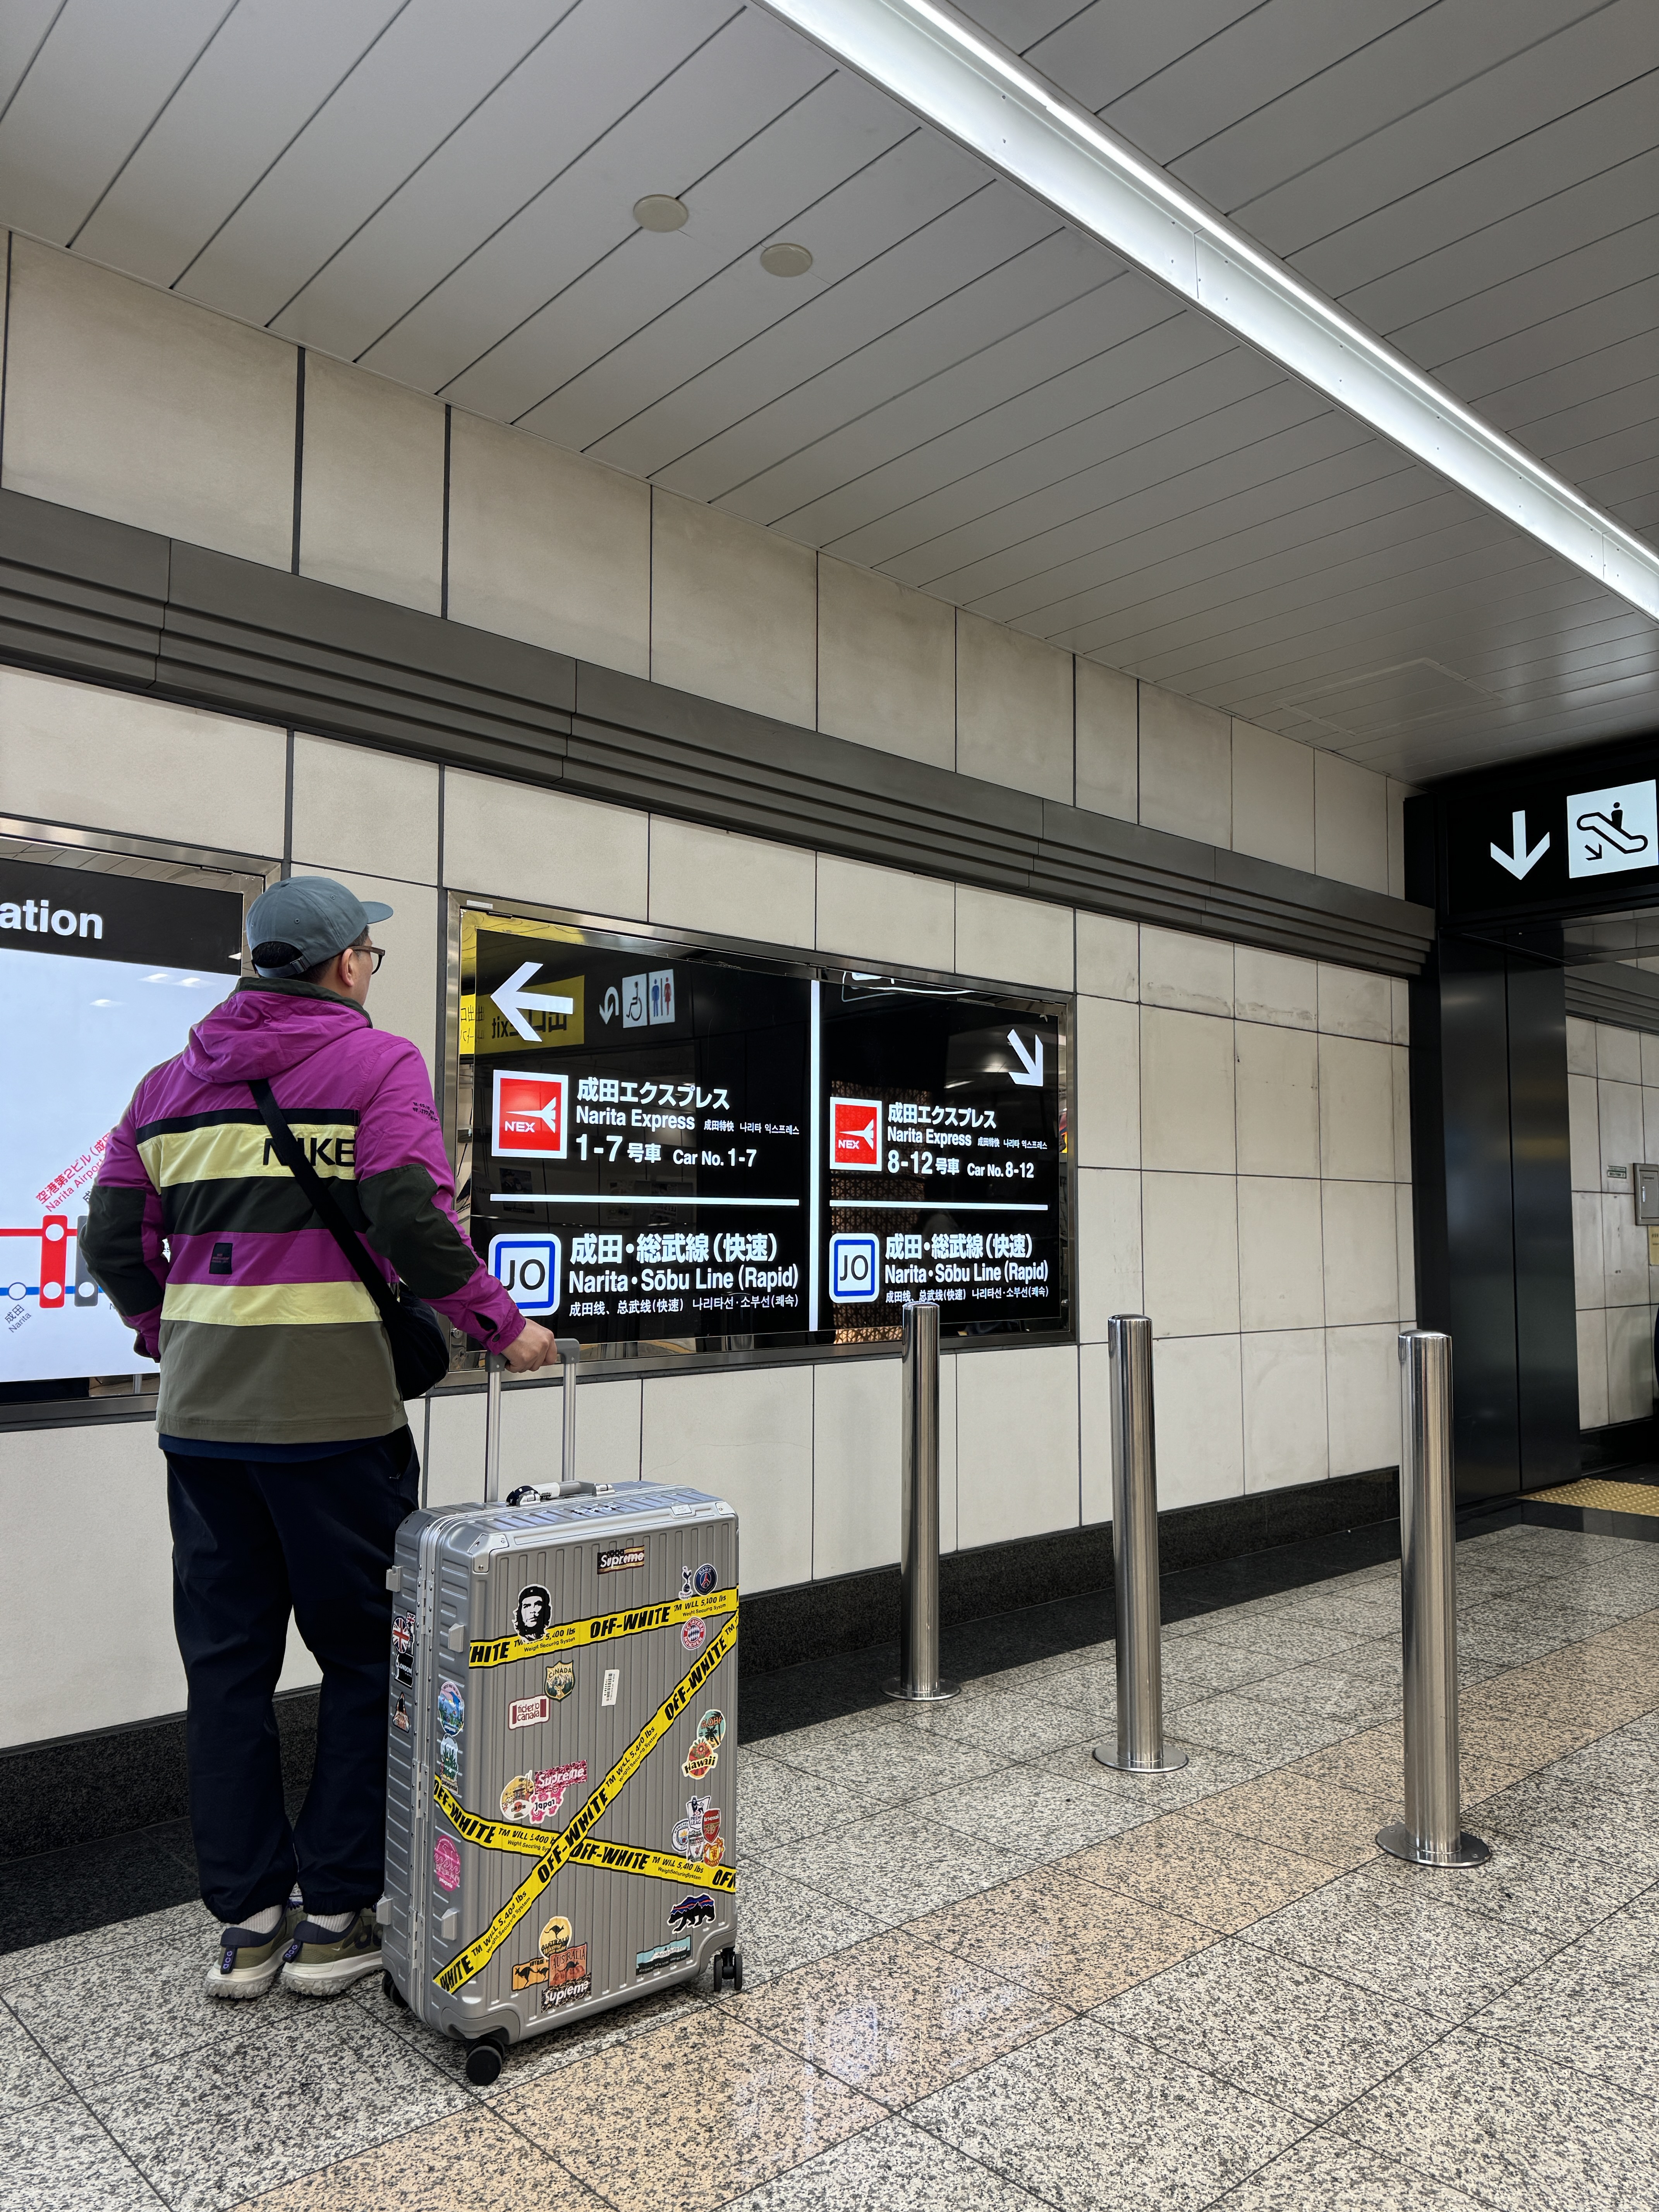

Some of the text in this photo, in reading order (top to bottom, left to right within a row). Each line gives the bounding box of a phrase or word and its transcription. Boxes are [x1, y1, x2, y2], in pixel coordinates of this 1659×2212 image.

[0, 900, 102, 939] ation
[577, 1077, 730, 1111] 成田エクスプレス
[577, 1106, 695, 1132] Narita Express
[704, 1120, 734, 1131] 成田特快
[888, 1102, 996, 1129] 成田エクスプレス
[740, 1122, 799, 1135] 나리타 익스프레스
[888, 1126, 971, 1148] Narita Express
[263, 1137, 355, 1166] NIKE
[576, 1134, 661, 1163] 1-7 号車
[978, 1137, 1000, 1147] 成田特快
[1004, 1139, 1047, 1149] 나리타 익스프레스
[673, 1148, 756, 1167] Car No. 1-7
[888, 1150, 959, 1175] 8-12 号車
[967, 1162, 1034, 1178] Car No. 8-12
[45, 1187, 74, 1212] Narita
[504, 1259, 545, 1291] JO
[696, 1268, 733, 1289] Line
[738, 1264, 798, 1295] (Rapid)
[840, 1255, 868, 1280] JO
[974, 1263, 1001, 1281] Line
[1005, 1260, 1048, 1284] (Rapid)
[5, 1304, 24, 1324] 成田
[9, 1313, 31, 1333] Narita
[600, 1552, 644, 1568] Supreme
[469, 1642, 510, 1663] HITE
[590, 1607, 670, 1638] OFF-WHITE
[517, 1710, 539, 1721] canada
[685, 1756, 716, 1774] Hawaii
[538, 1768, 584, 1787] Supreme
[471, 1944, 483, 1956] TM
[515, 1891, 527, 1903] lbs
[538, 1788, 608, 1883] OFF-WHITE
[606, 1775, 616, 1787] TM
[644, 1726, 655, 1738] lbs
[665, 1637, 727, 1721] OFF-WHITE
[725, 1624, 734, 1635] TM
[434, 1779, 496, 1844] OFF-WHITE
[498, 1828, 510, 1837] TM
[569, 1842, 650, 1870] OFF-WHITE
[694, 1865, 704, 1873] lbs
[552, 1949, 586, 1970] AUSTRALIA
